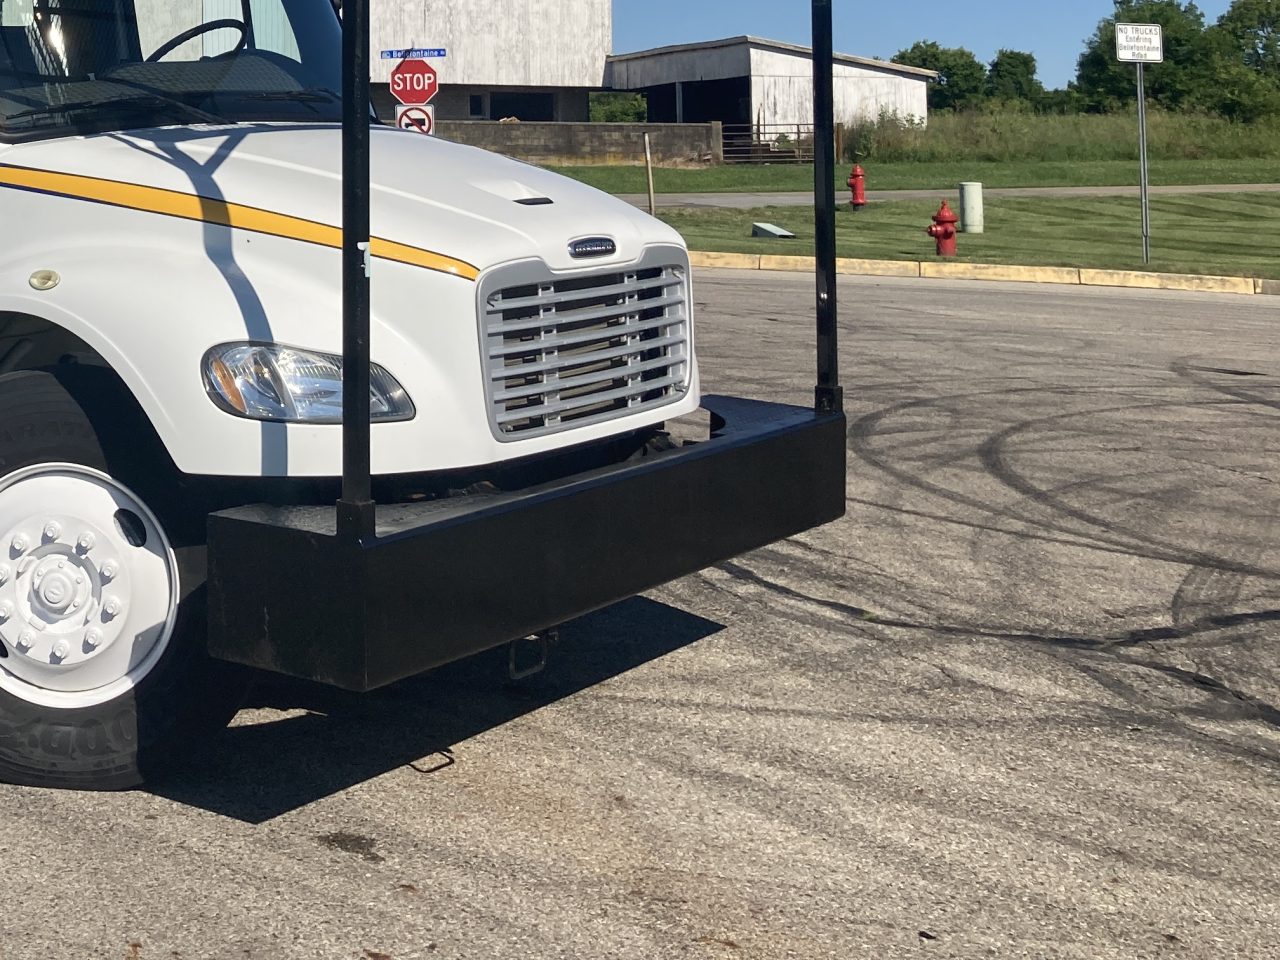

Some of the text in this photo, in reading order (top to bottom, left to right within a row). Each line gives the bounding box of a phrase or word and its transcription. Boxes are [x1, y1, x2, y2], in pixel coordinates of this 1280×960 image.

[1118, 26, 1159, 36] NO TRUCKS
[392, 50, 438, 58] Belefontaine
[393, 73, 435, 91] STOP
